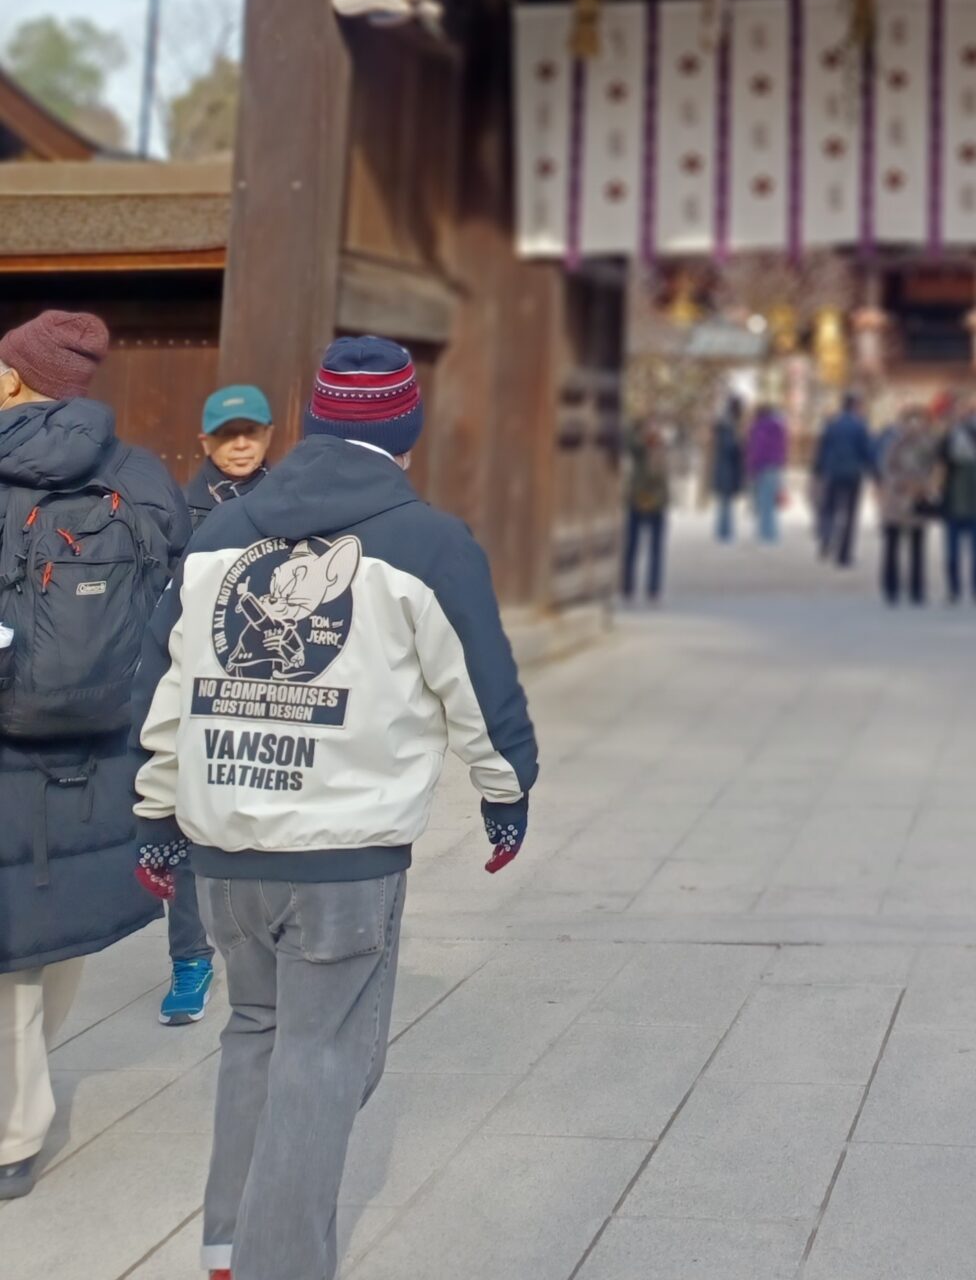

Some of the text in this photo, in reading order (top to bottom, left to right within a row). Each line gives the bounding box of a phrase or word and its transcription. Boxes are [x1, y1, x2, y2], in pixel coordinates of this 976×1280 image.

[214, 609, 226, 628] ALL
[309, 615, 330, 628] TOM
[214, 631, 228, 654] FOR
[306, 630, 342, 646] JERRY
[198, 680, 339, 707] NO COMPROMISES
[212, 699, 313, 720] CUSTOM DESIGN
[204, 729, 316, 768] VANSON
[207, 764, 303, 791] LEATHERS
